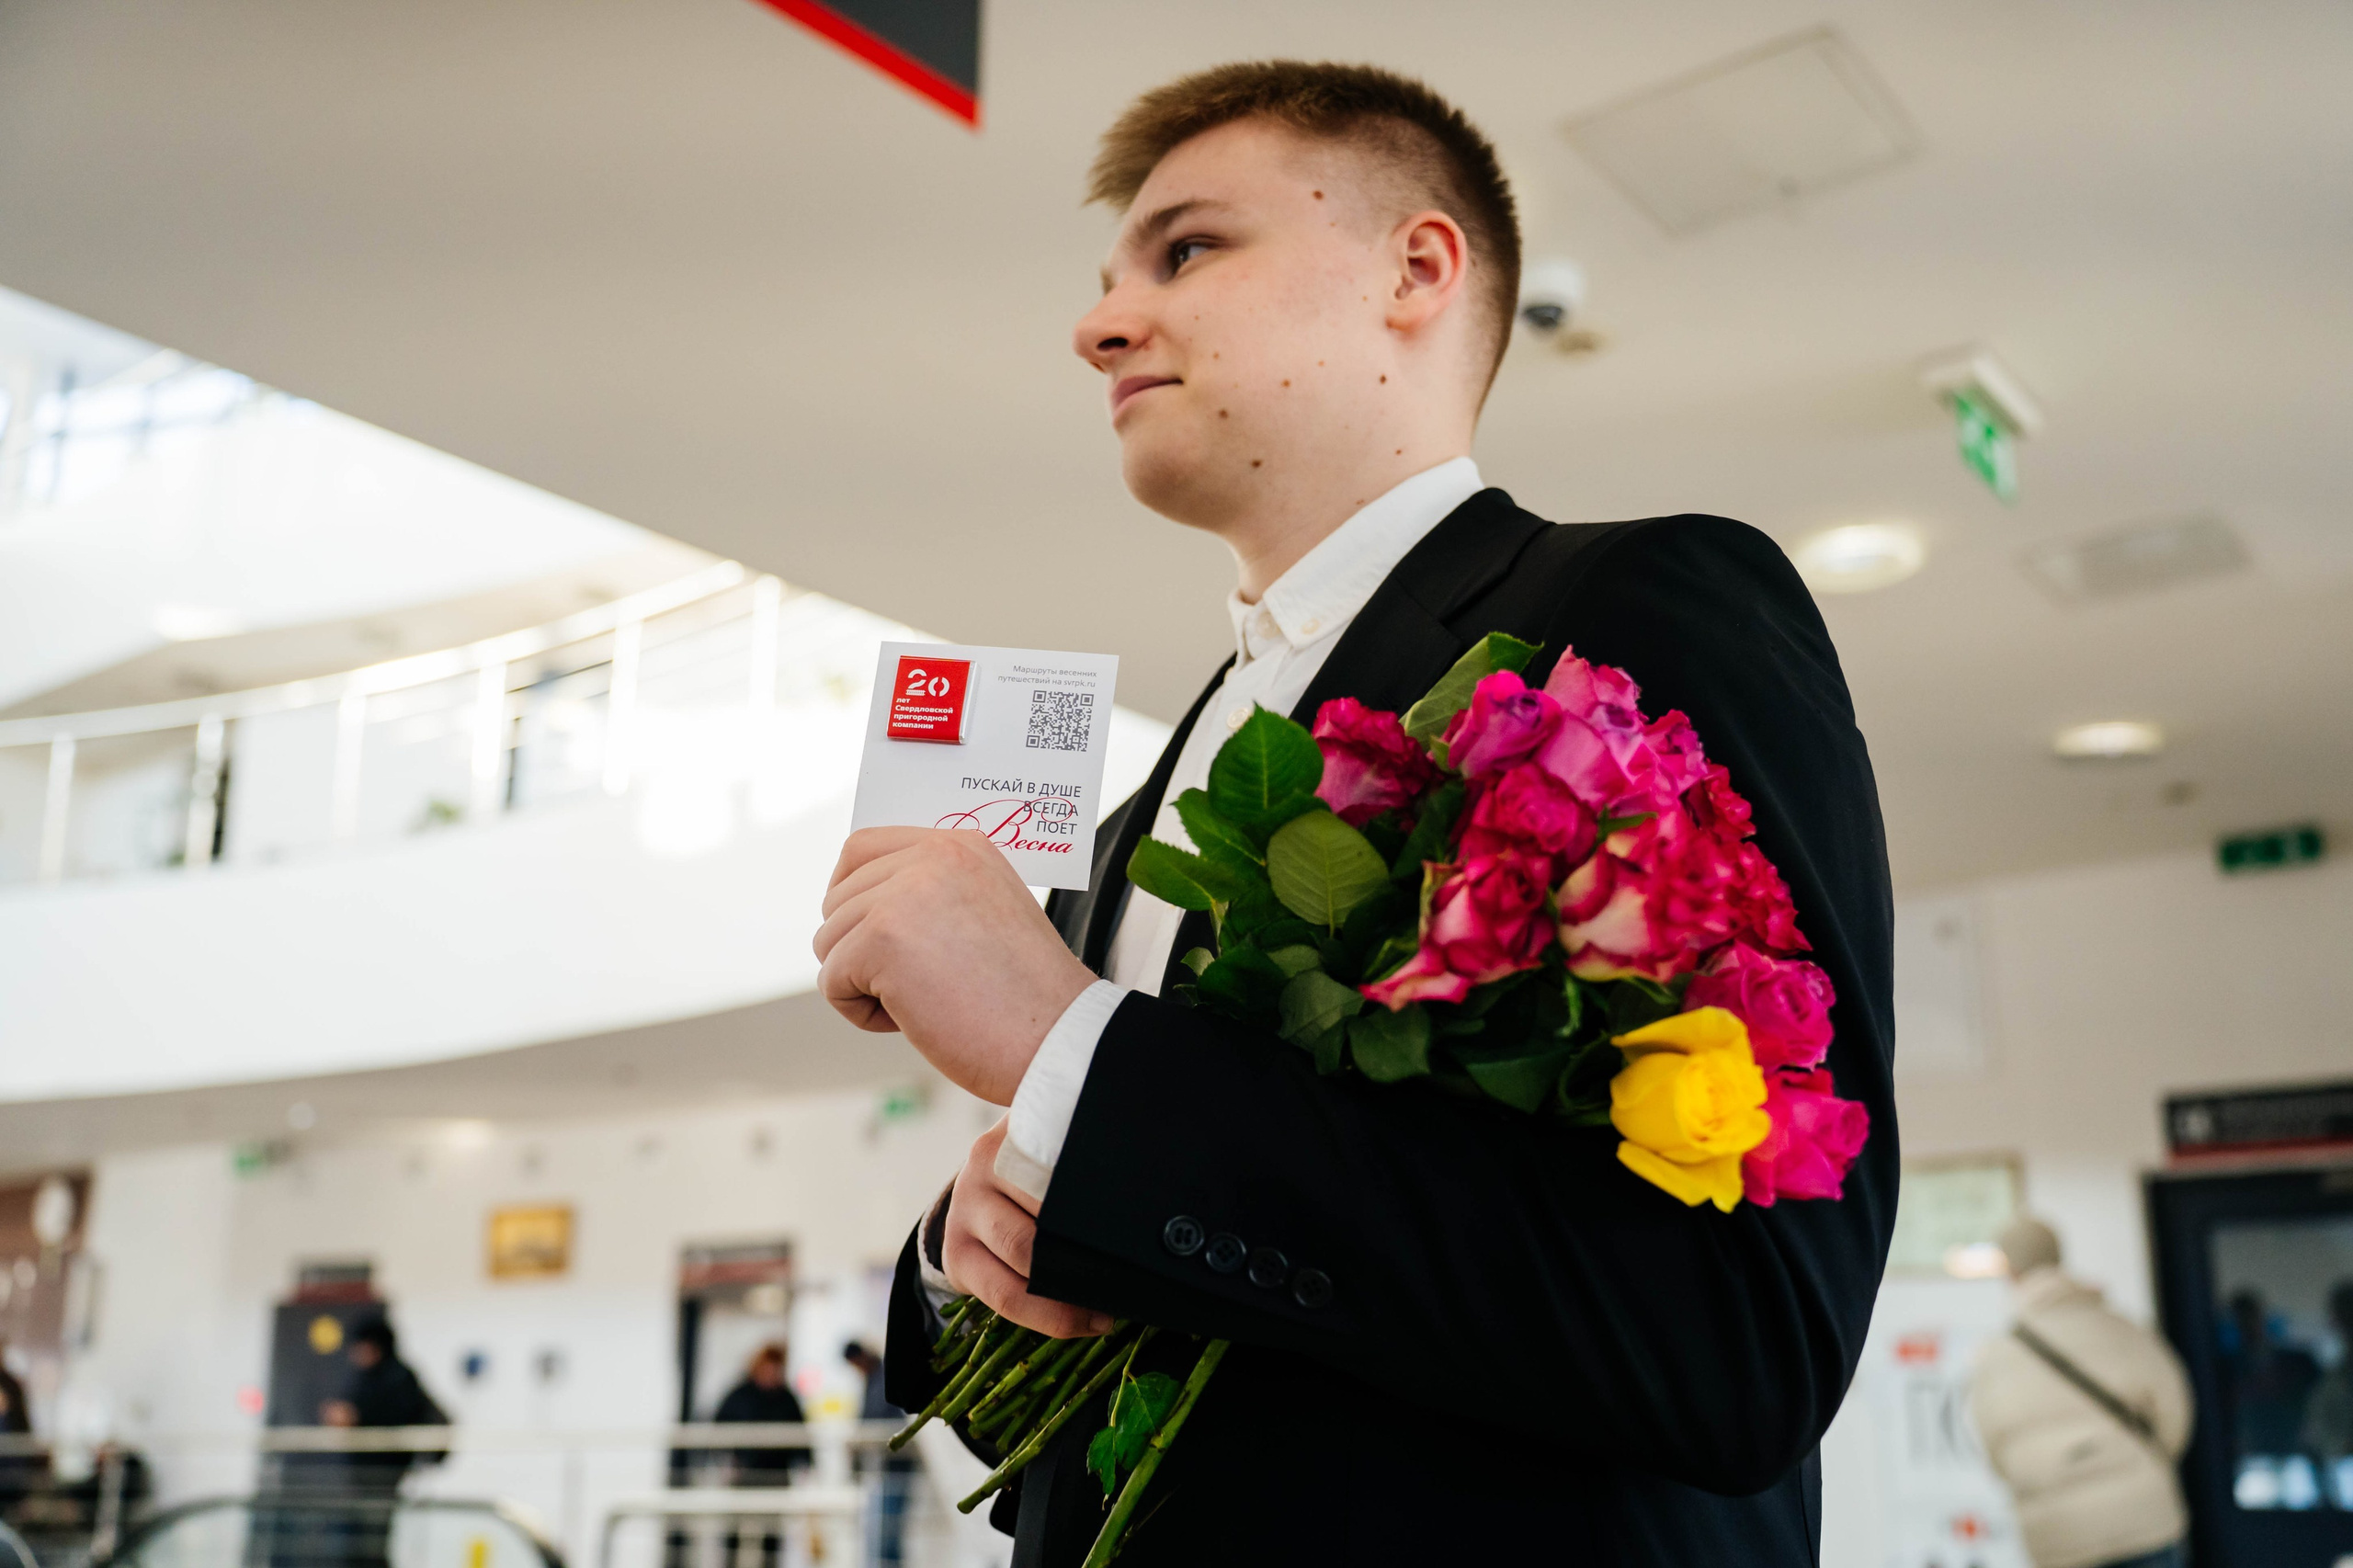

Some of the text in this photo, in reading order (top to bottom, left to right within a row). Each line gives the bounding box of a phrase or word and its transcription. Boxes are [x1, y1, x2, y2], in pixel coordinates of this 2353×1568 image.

[1013, 665, 1097, 677] Маршруты весенних
[906, 668, 949, 697] 20
[998, 675, 1051, 685] путешествий
[1063, 679, 1096, 687] svrpk.ru
[895, 706, 953, 714] Свердловской
[893, 713, 948, 722] пригородной
[892, 722, 934, 730] компании
[961, 777, 1081, 798] ПУСКАЙ В ДУШЕ
[1024, 801, 1078, 816] ВСЕГДА
[1037, 821, 1077, 835] ПОЕТ
